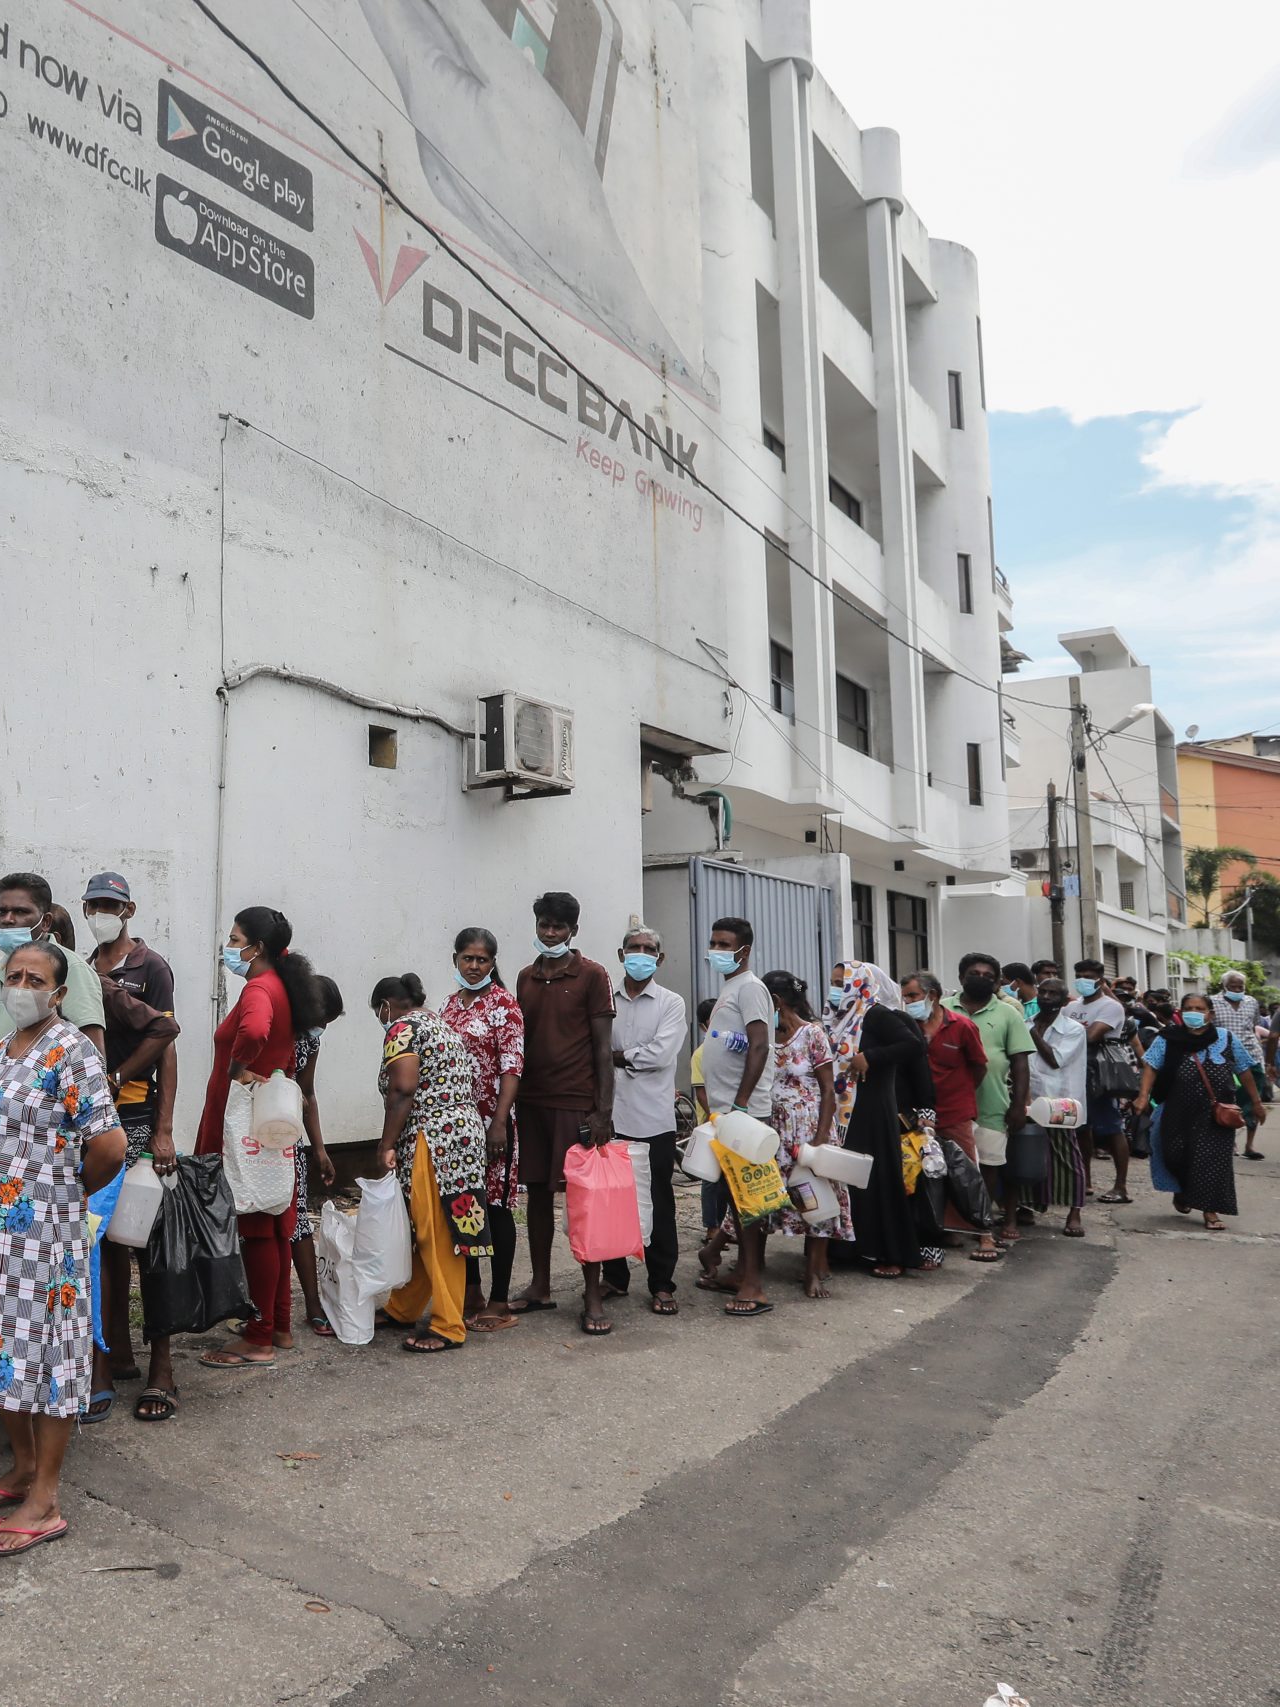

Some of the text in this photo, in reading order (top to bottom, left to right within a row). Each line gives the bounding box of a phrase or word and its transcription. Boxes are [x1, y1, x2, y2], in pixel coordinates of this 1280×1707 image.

[20, 39, 88, 102] now
[98, 84, 142, 136] via
[27, 112, 152, 197] www.dfcc.lk
[202, 126, 306, 214] Google play
[199, 201, 286, 260] Download on the
[423, 280, 700, 488] DFCC BANK
[576, 436, 704, 532] Keep Growing
